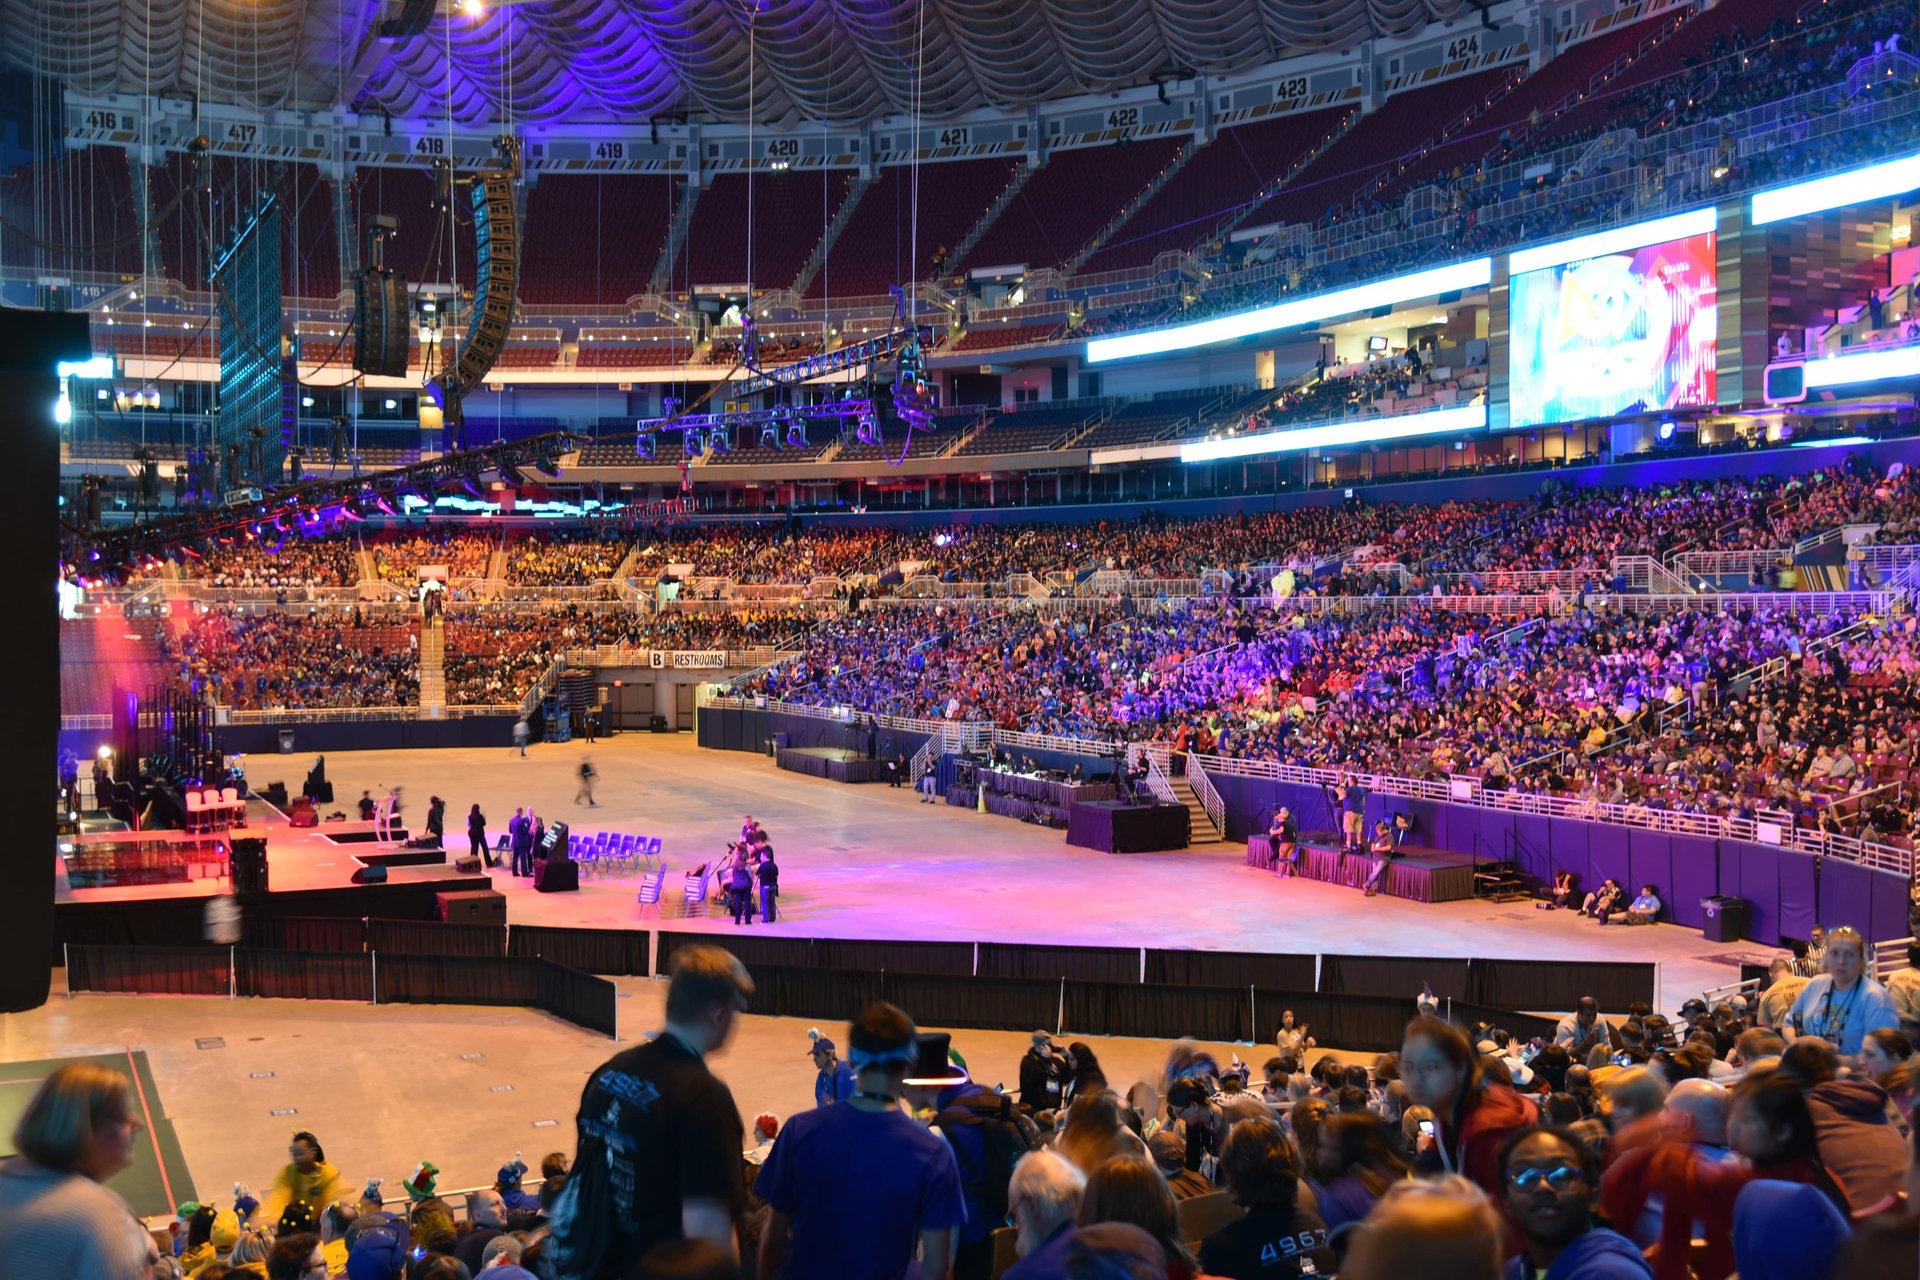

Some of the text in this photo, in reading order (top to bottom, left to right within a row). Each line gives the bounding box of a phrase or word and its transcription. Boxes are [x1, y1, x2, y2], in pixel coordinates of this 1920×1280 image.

[1447, 35, 1478, 59] 424
[1277, 77, 1307, 98] 423
[86, 111, 117, 129] 416
[1108, 108, 1138, 127] 422
[228, 124, 257, 142] 417
[940, 128, 968, 145] 421
[416, 137, 444, 154] 418
[596, 142, 623, 159] 419
[769, 140, 799, 156] 420
[81, 286, 101, 298] 416
[653, 653, 723, 666] B RESTROOMS
[1260, 1228, 1326, 1261] 4967
